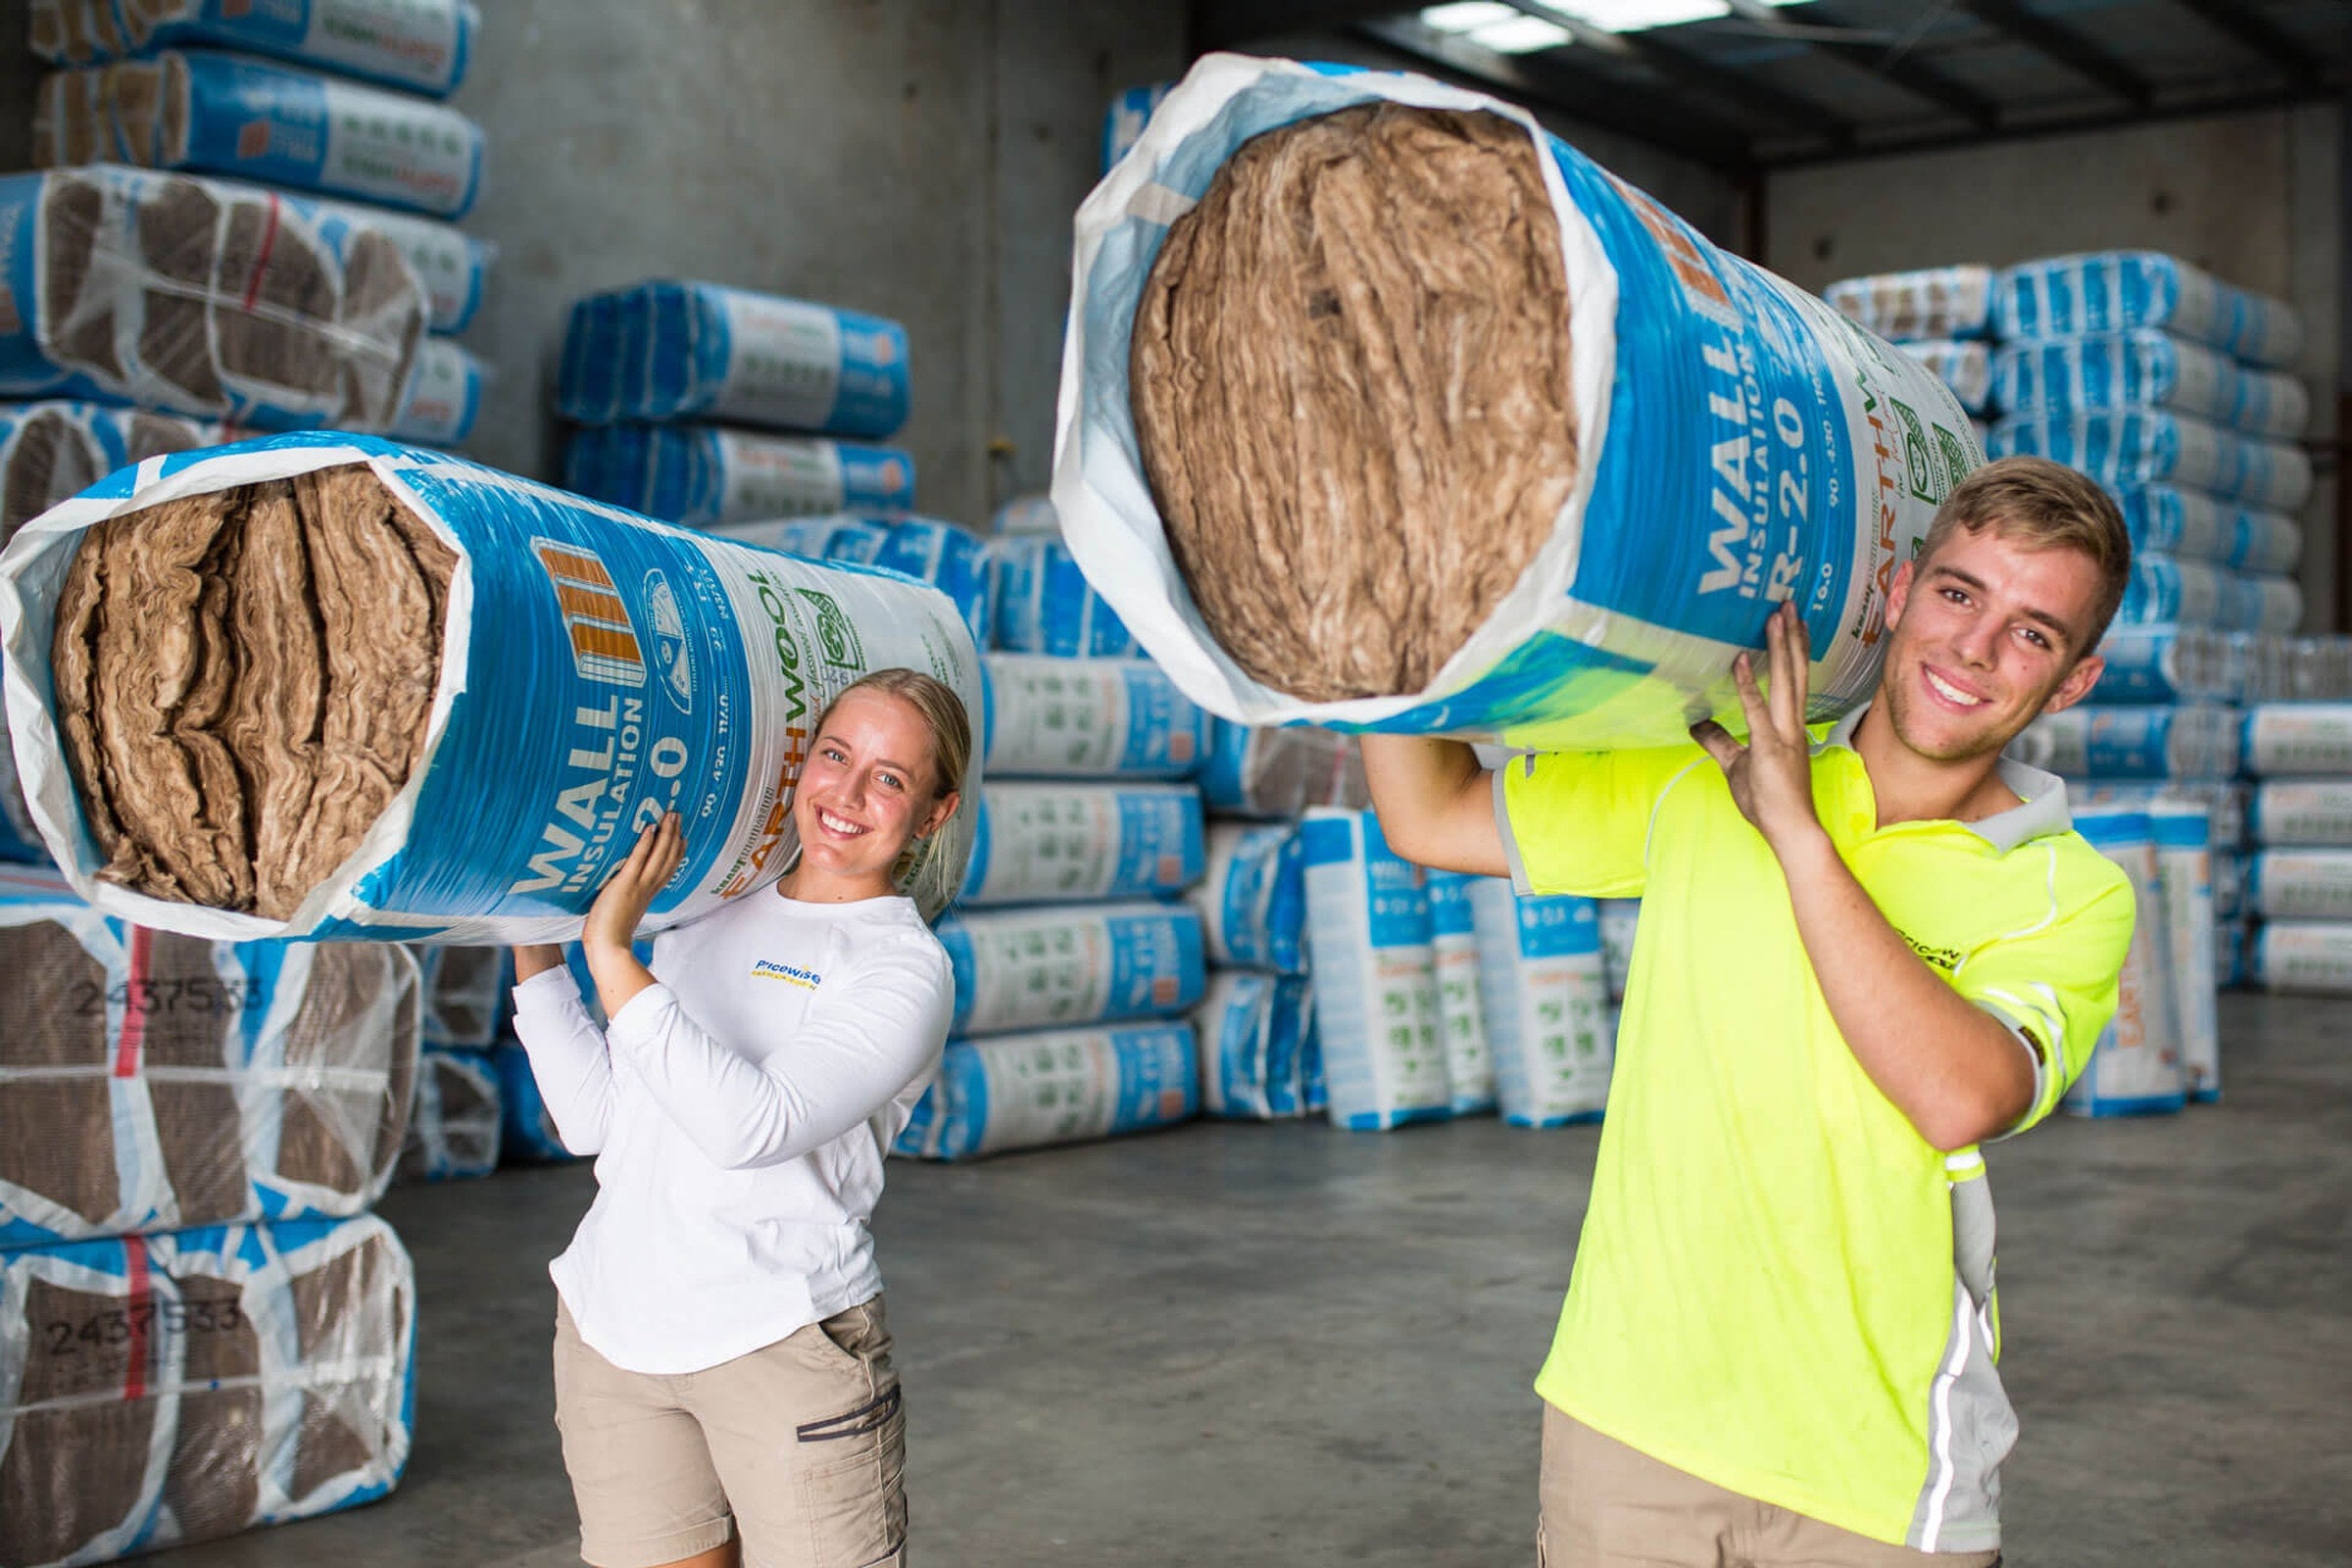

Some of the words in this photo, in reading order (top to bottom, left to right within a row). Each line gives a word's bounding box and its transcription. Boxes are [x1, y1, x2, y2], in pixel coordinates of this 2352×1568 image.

[1698, 336, 1748, 595] WALL
[1740, 343, 1769, 599] INSULATION
[1765, 397, 1807, 603] R-2.0
[508, 694, 618, 895] WALL
[562, 699, 643, 893] INSULATION
